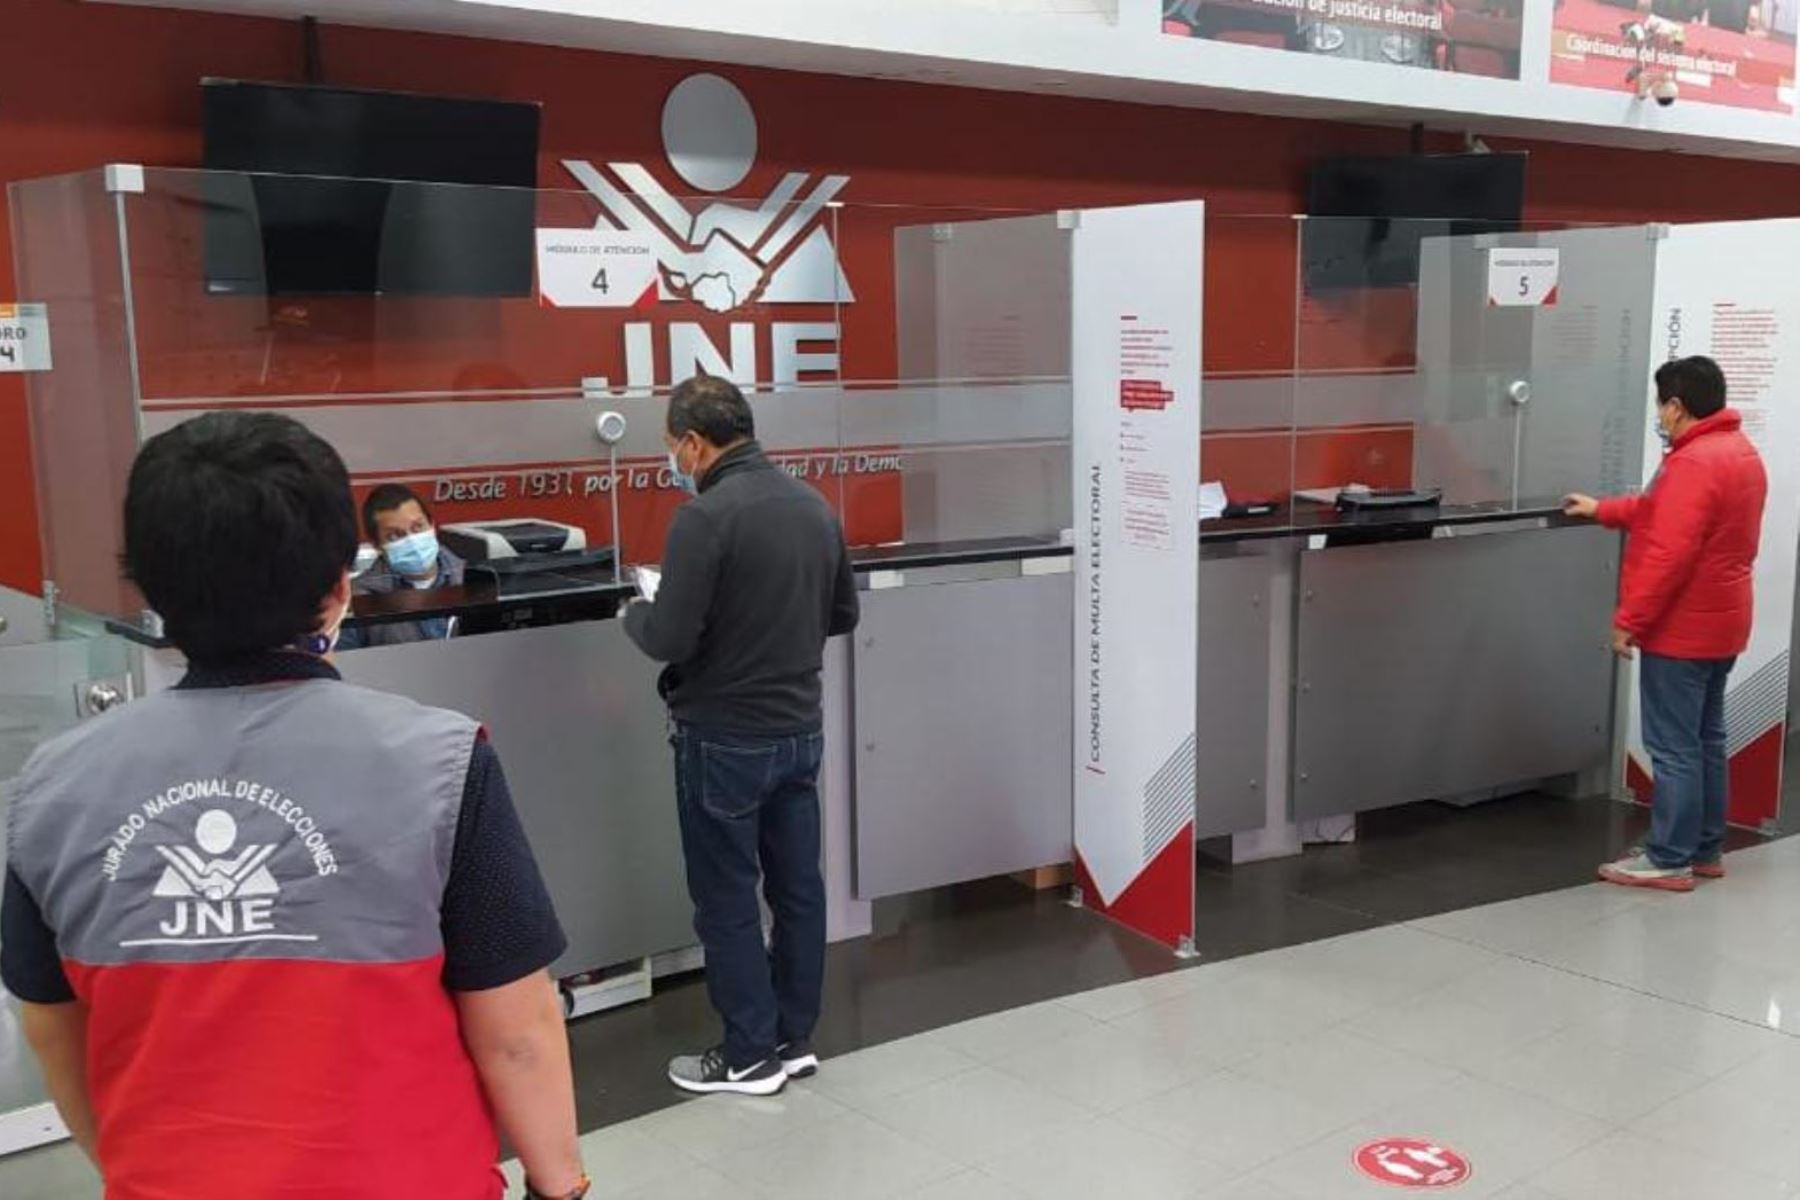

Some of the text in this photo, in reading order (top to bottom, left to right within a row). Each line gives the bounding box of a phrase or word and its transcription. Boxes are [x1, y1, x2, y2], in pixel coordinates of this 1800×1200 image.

[1328, 1, 1381, 20] justicia
[1385, 6, 1442, 30] electoral
[591, 267, 609, 294] 4
[1519, 276, 1528, 296] 5
[0, 326, 27, 340] RO
[1667, 307, 1682, 361] PCIÓN
[582, 322, 841, 399] JNE
[434, 476, 506, 501] Desde
[584, 473, 621, 497] por
[628, 468, 649, 488] la
[816, 460, 827, 479] y
[832, 458, 850, 475] la
[1090, 463, 1102, 763] CONSULTA DE MULTA ELECTORAL
[102, 779, 338, 882] JURADO NACIONAL DE ELECCIONES
[160, 899, 275, 936] JNE
